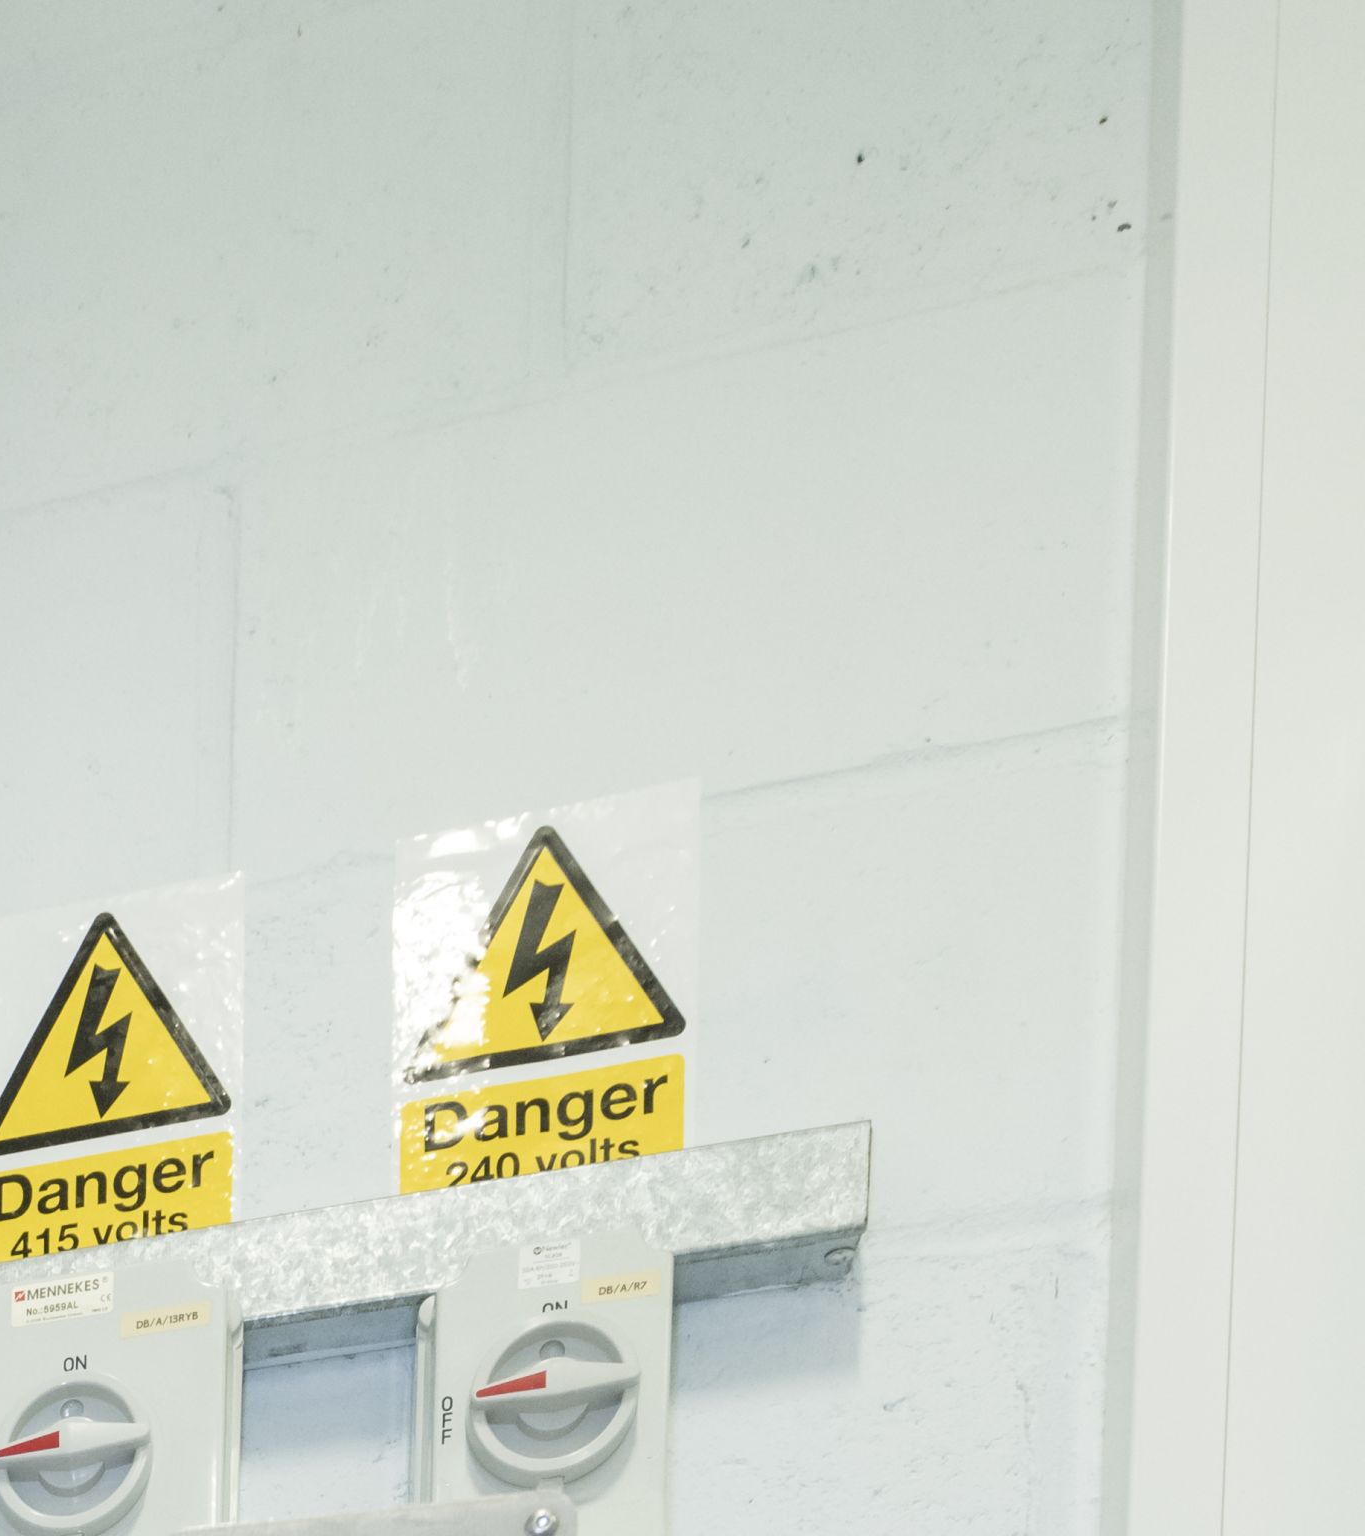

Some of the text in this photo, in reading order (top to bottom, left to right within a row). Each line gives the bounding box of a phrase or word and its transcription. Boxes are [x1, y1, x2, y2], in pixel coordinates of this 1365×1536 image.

[424, 1074, 668, 1153] Danger
[445, 1137, 641, 1187] 240 volts
[10, 1209, 189, 1259] 415 volts
[26, 1278, 100, 1301] MENNEKES
[542, 1299, 568, 1313] ON
[598, 1281, 648, 1297] DB/A/R7
[63, 1354, 88, 1372] ON
[441, 1396, 453, 1444] OFF
